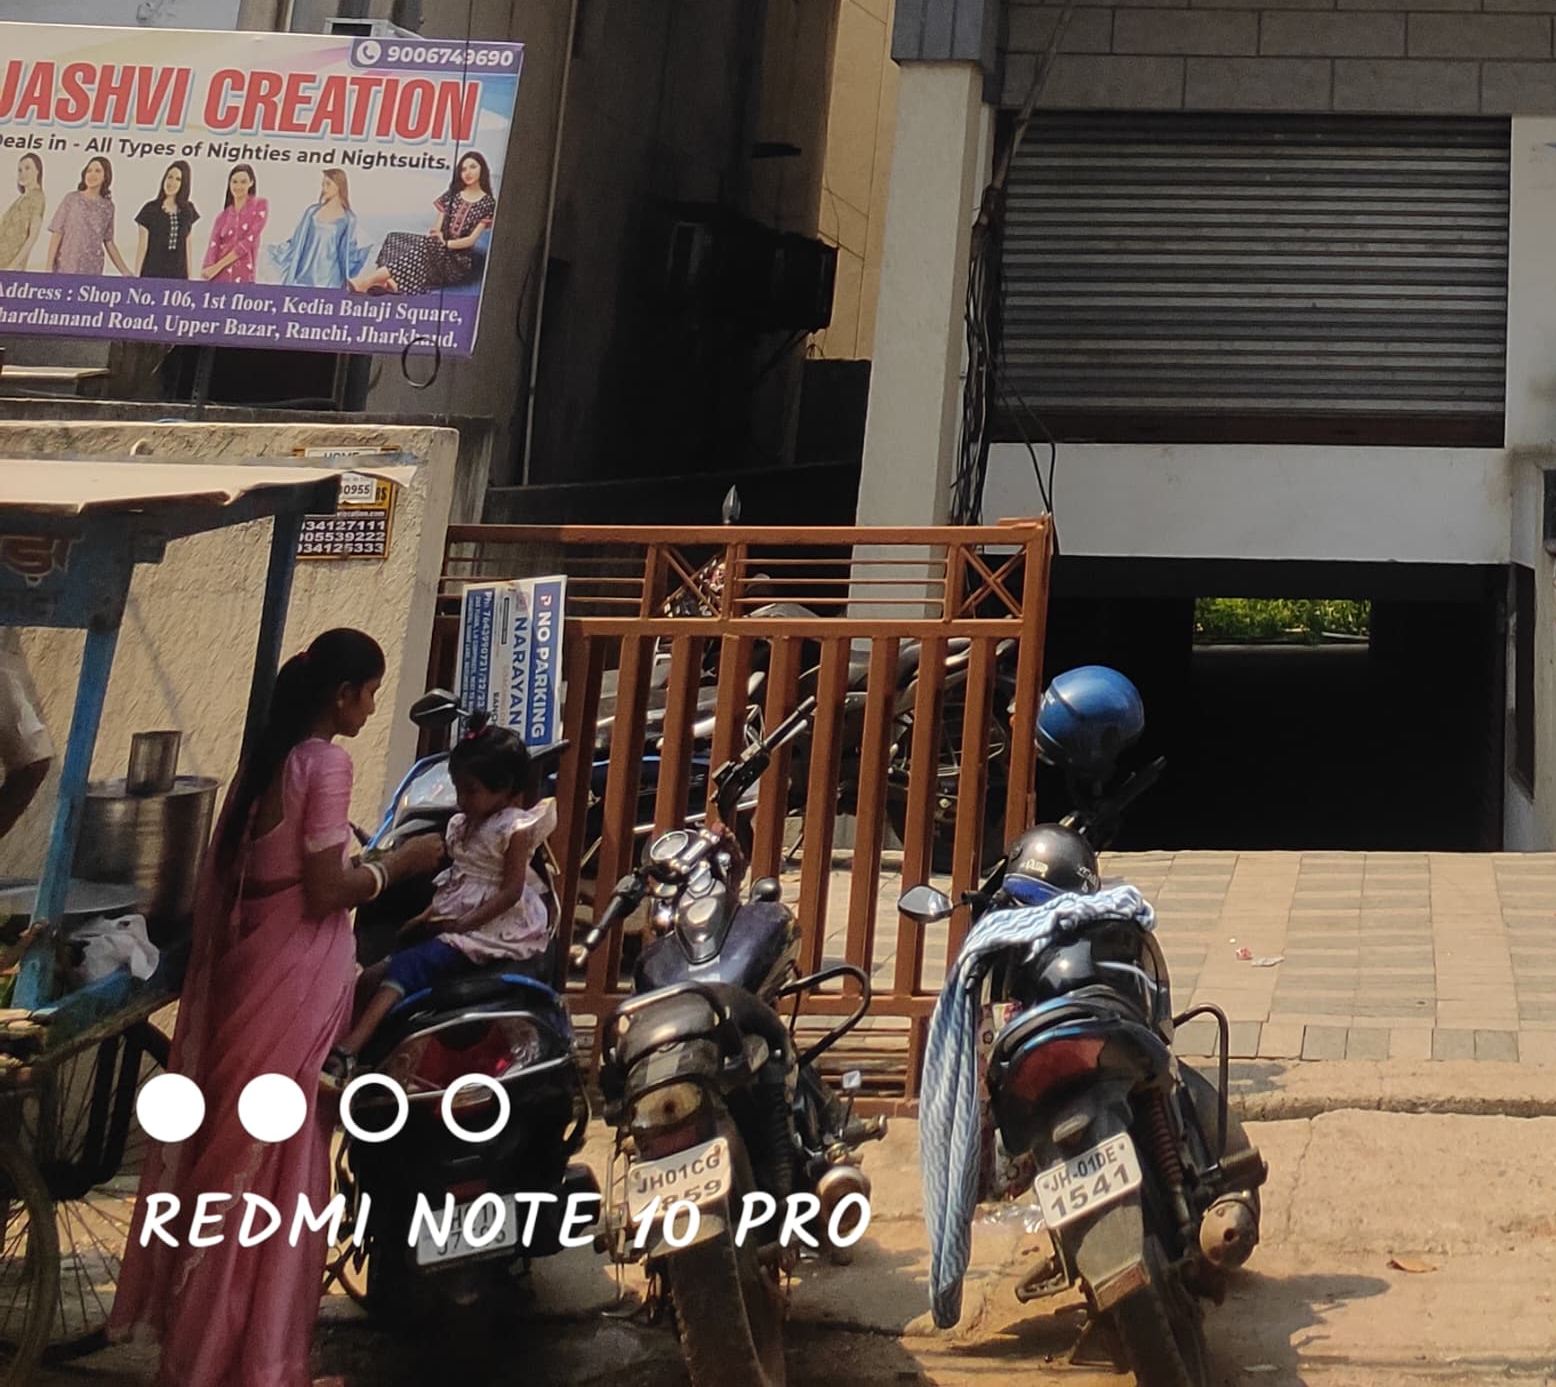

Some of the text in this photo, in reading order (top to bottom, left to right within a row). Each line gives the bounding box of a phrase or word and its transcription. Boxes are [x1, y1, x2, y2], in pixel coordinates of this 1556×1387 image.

[203, 69, 481, 141] CREATION
[49, 134, 67, 151] in
[85, 137, 113, 153] All
[119, 138, 176, 159] Types
[181, 141, 203, 157] of
[207, 143, 291, 166] Nighties
[297, 148, 334, 165] and
[342, 150, 450, 172] Nightsuits.
[78, 285, 122, 309] Shop
[127, 288, 156, 306] No.
[162, 290, 196, 310] 106,
[202, 292, 226, 309] 1st
[231, 292, 278, 315] floor,
[282, 296, 334, 316] Kedia
[339, 299, 392, 322] Balaji
[395, 303, 463, 326] Square,
[108, 312, 159, 333] Road,
[165, 315, 220, 338] Upper
[224, 318, 280, 341] Bazar,
[286, 322, 352, 344] Ranchi,
[537, 611, 552, 643] NO
[531, 647, 551, 739] PARKING
[637, 1155, 721, 1194] JH01CG
[1051, 1163, 1130, 1218] 1541
